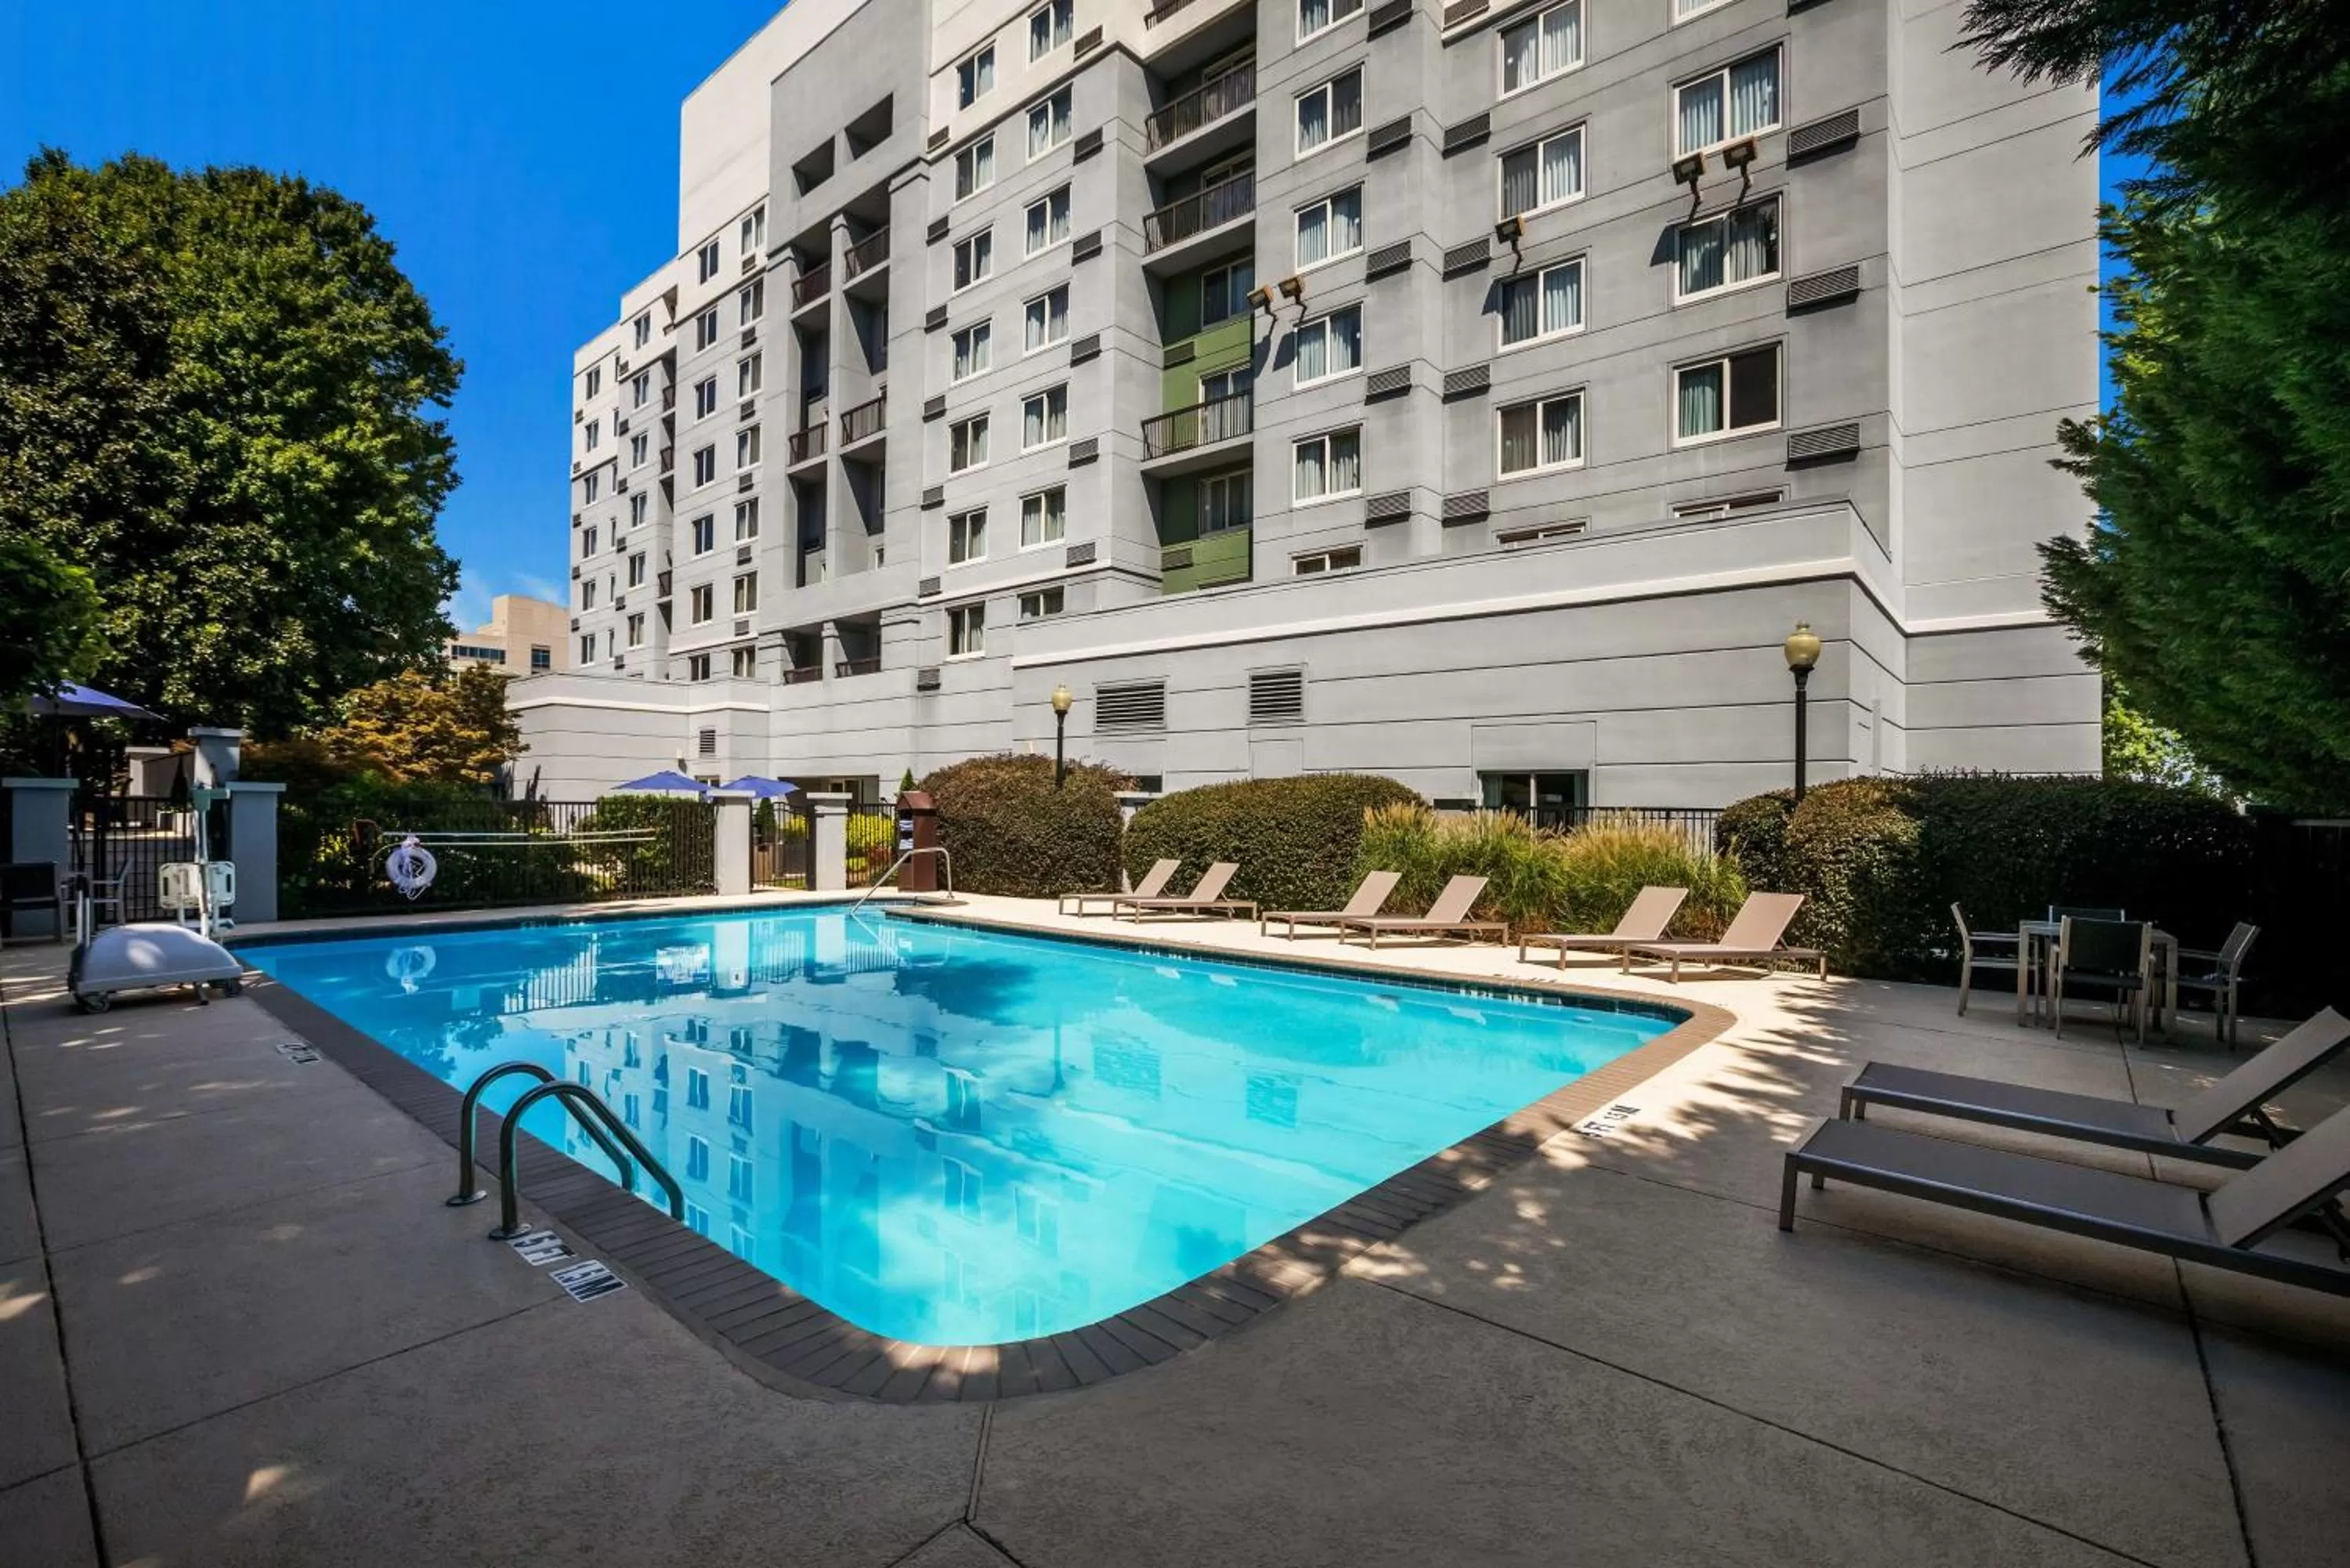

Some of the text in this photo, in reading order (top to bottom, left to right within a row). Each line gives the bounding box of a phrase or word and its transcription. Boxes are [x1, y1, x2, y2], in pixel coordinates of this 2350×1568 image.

[514, 1234, 576, 1263] 5 FT
[554, 1262, 624, 1300] 1.5 M
